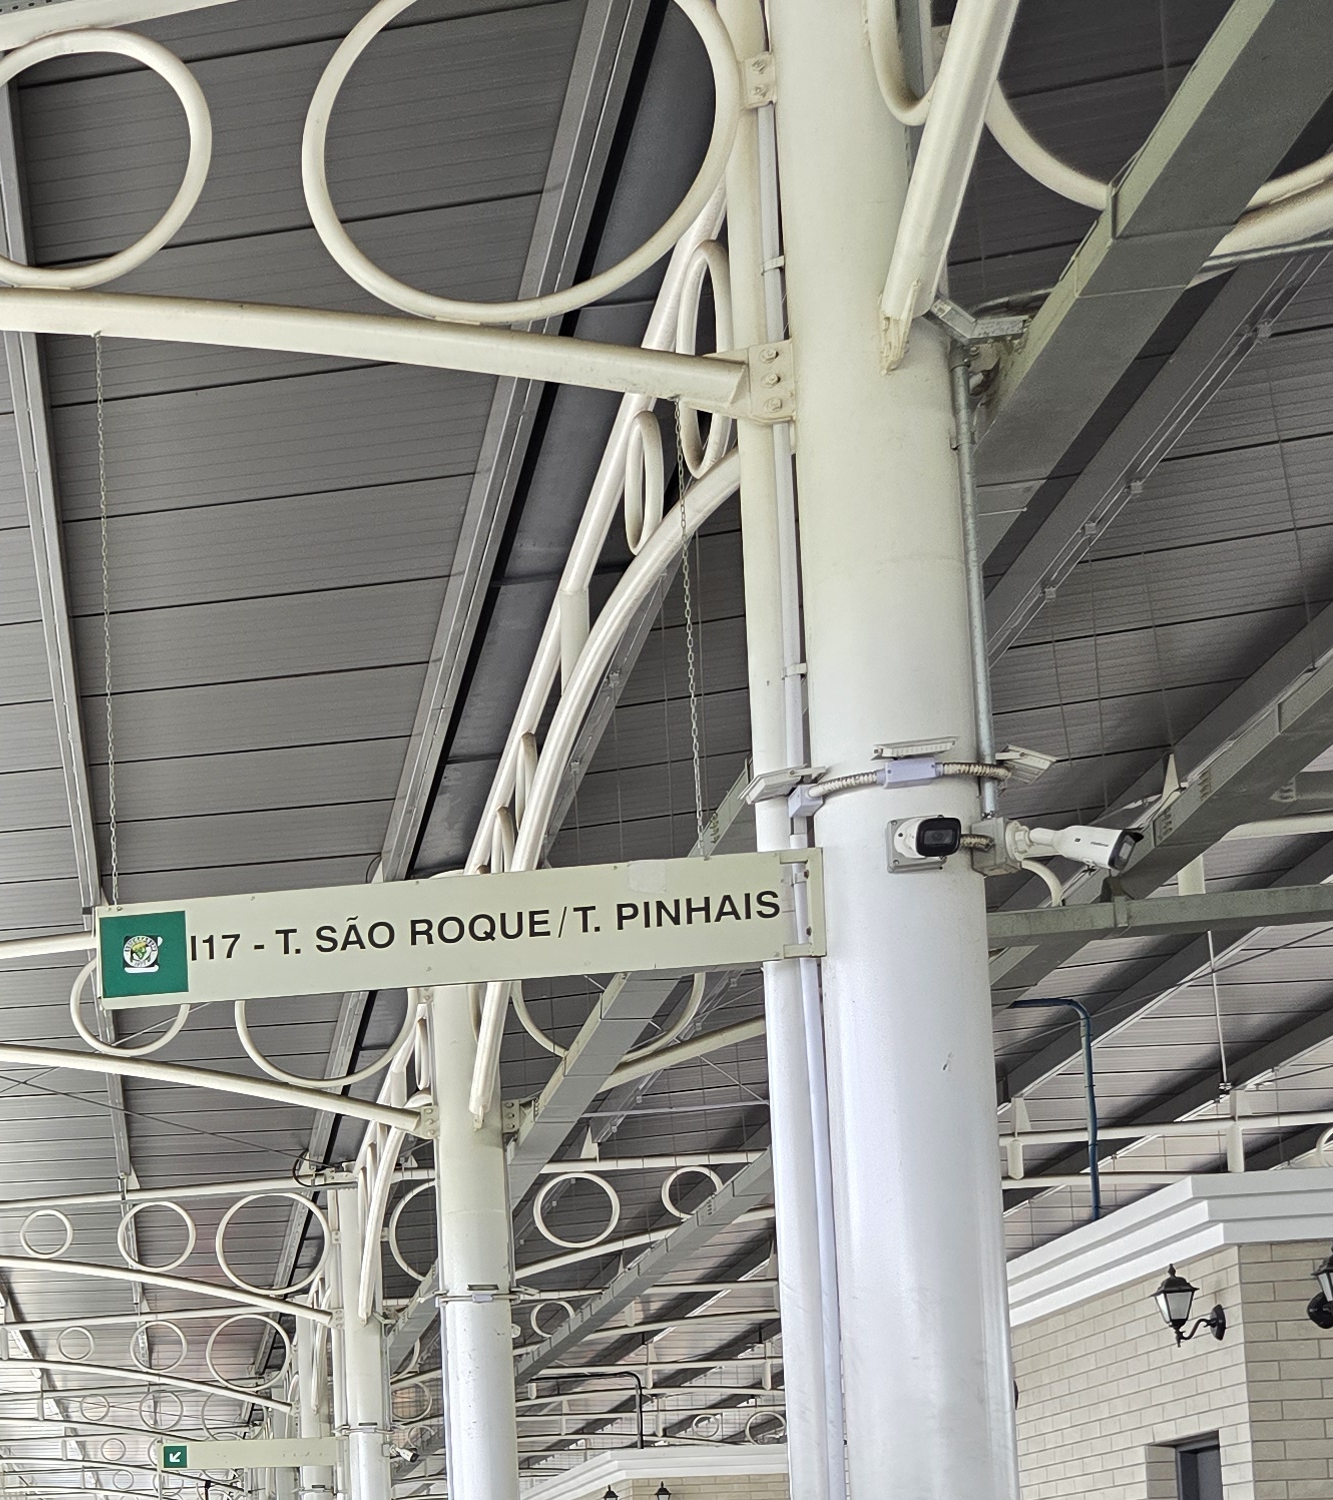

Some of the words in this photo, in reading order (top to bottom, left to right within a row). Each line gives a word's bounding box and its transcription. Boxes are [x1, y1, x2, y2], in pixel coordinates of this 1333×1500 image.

[275, 928, 302, 955] T.
[316, 915, 396, 953] SÃO
[616, 890, 781, 931] PINHAIS
